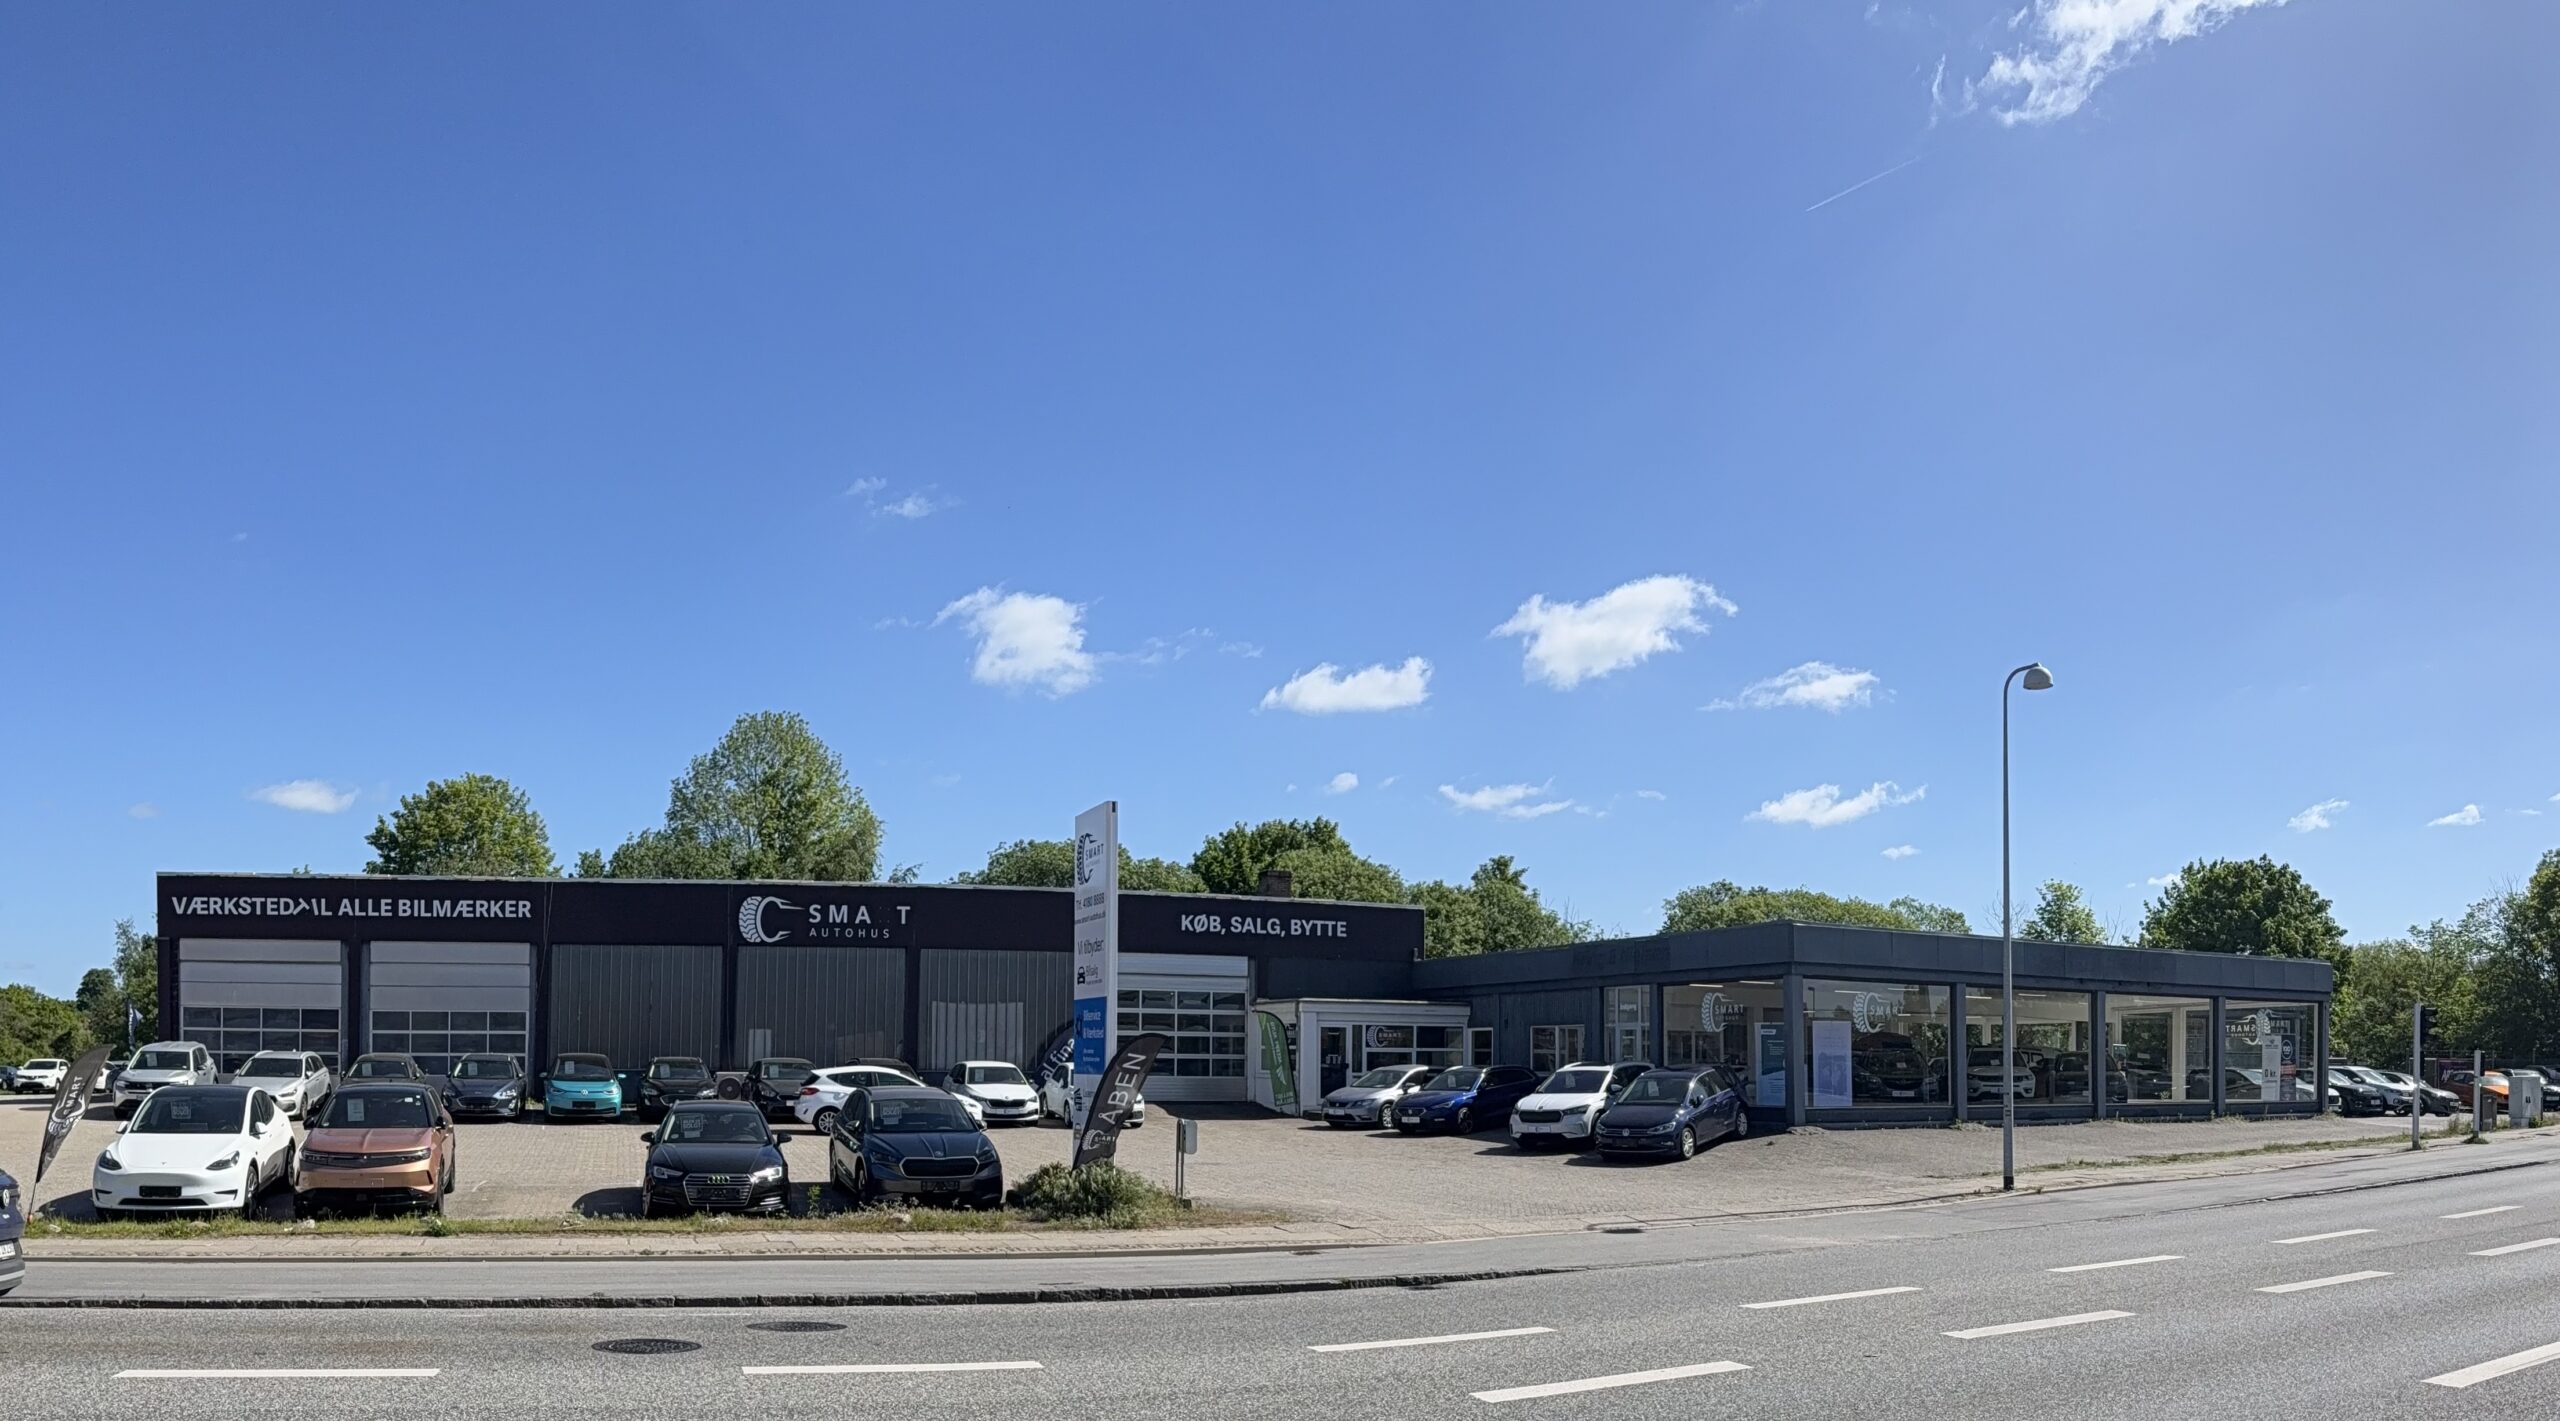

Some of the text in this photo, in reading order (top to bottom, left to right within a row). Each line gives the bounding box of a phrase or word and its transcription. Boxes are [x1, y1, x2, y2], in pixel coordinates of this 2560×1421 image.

[1085, 843, 1104, 861] SMART
[338, 898, 393, 917] ALLE
[398, 899, 532, 919] BILMÆRKER
[809, 927, 890, 939] AUTOHUS
[1181, 914, 1348, 938] KØB, SALG, BYTTE
[1714, 1004, 1745, 1015] SMART
[1870, 1005, 1905, 1016] SMART
[63, 1076, 83, 1115] SMART
[1098, 1053, 1147, 1125] ÅBEN
